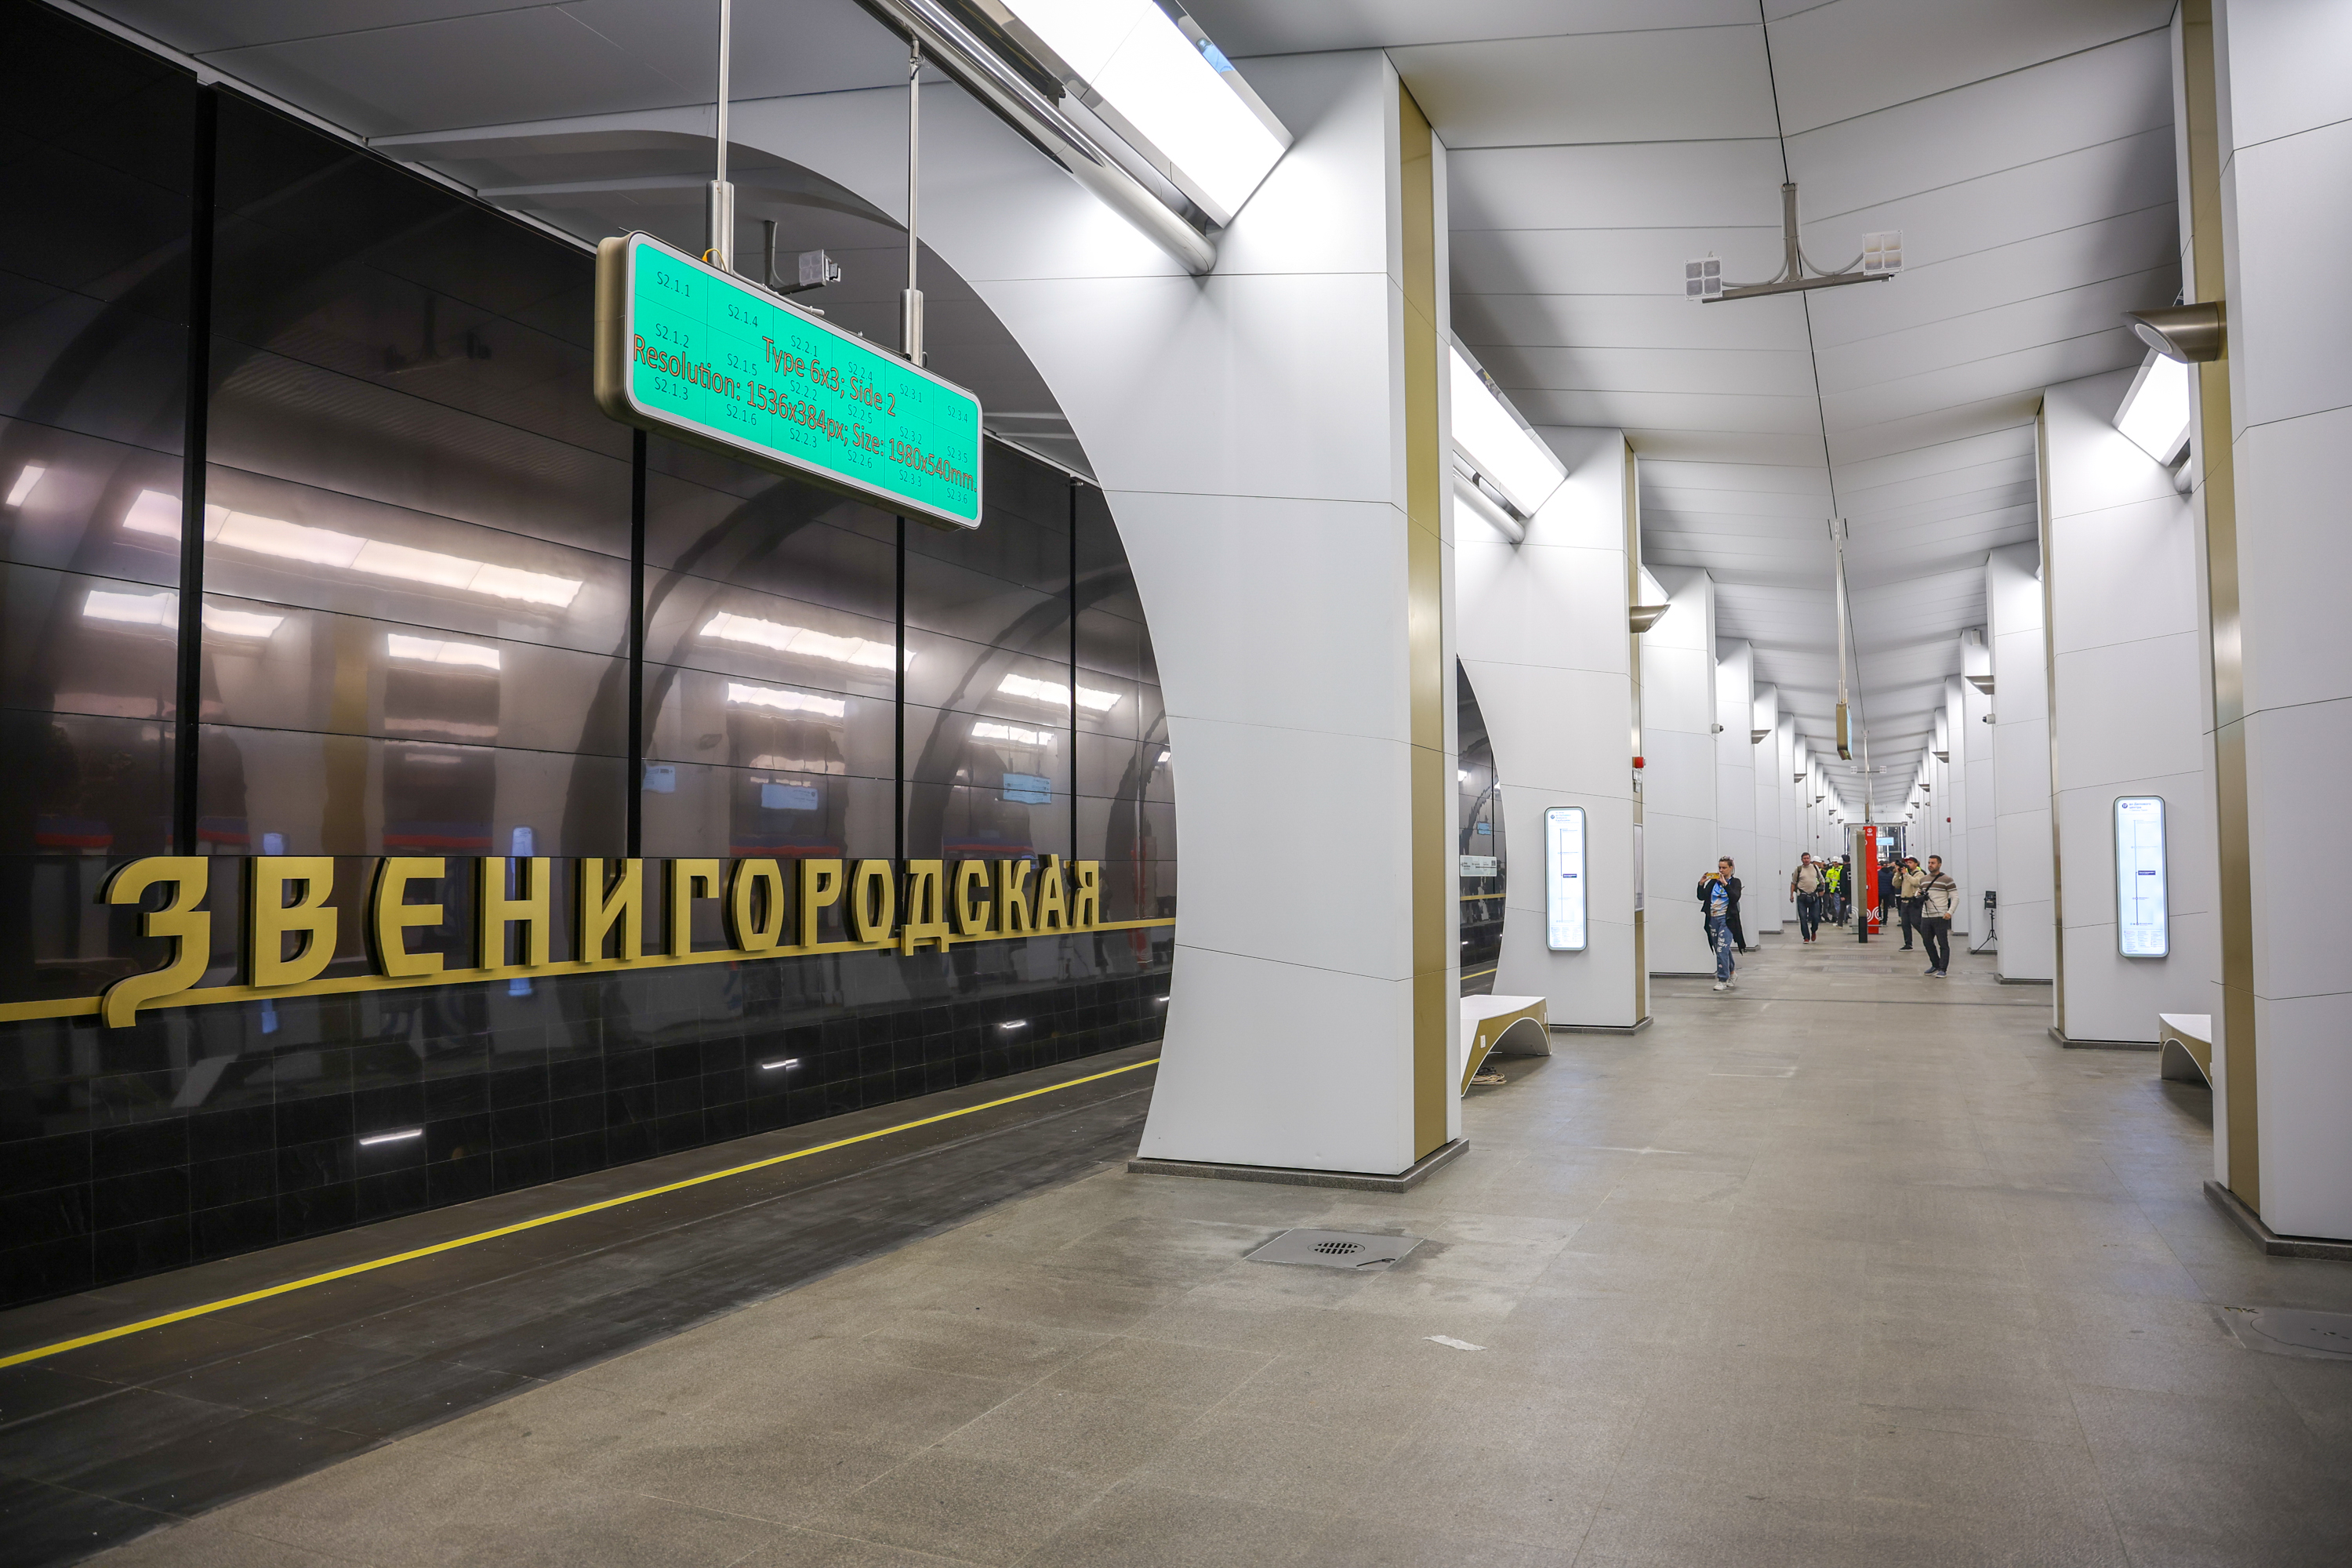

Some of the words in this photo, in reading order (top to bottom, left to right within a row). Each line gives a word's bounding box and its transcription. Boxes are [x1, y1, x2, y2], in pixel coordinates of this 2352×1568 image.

[657, 271, 690, 298] S2.1.1
[728, 304, 758, 328] S2.1.4
[655, 323, 688, 348] S2.1.2
[791, 336, 818, 358] S2.2.1
[727, 354, 757, 376] S2.1.5
[848, 361, 873, 380] S2.2.4
[762, 336, 804, 377] Type
[810, 359, 845, 398] 6x3;
[850, 378, 883, 410] Side
[887, 394, 896, 416] 2
[655, 377, 688, 400] S2.1.3
[790, 380, 818, 401] S2.2.2
[900, 384, 922, 402] S2.3.1
[633, 334, 741, 401] Resolution:
[747, 381, 849, 446] 1536x384px;
[852, 423, 884, 456] Size:
[889, 437, 977, 492] 1980x540mm.
[726, 404, 757, 425] S2.1.6
[848, 405, 873, 423] S2.2.5
[947, 406, 968, 423] S2.3.4
[789, 428, 817, 448] S2.2.3
[900, 427, 922, 445] S2.3.2
[848, 450, 873, 468] S2.2.6
[947, 446, 968, 463] S2.3.5
[899, 470, 922, 487] S2.3.3
[947, 487, 967, 503] S2.3.6
[100, 854, 1099, 1029] ЗВЕНИГОРОДСКАЯ
